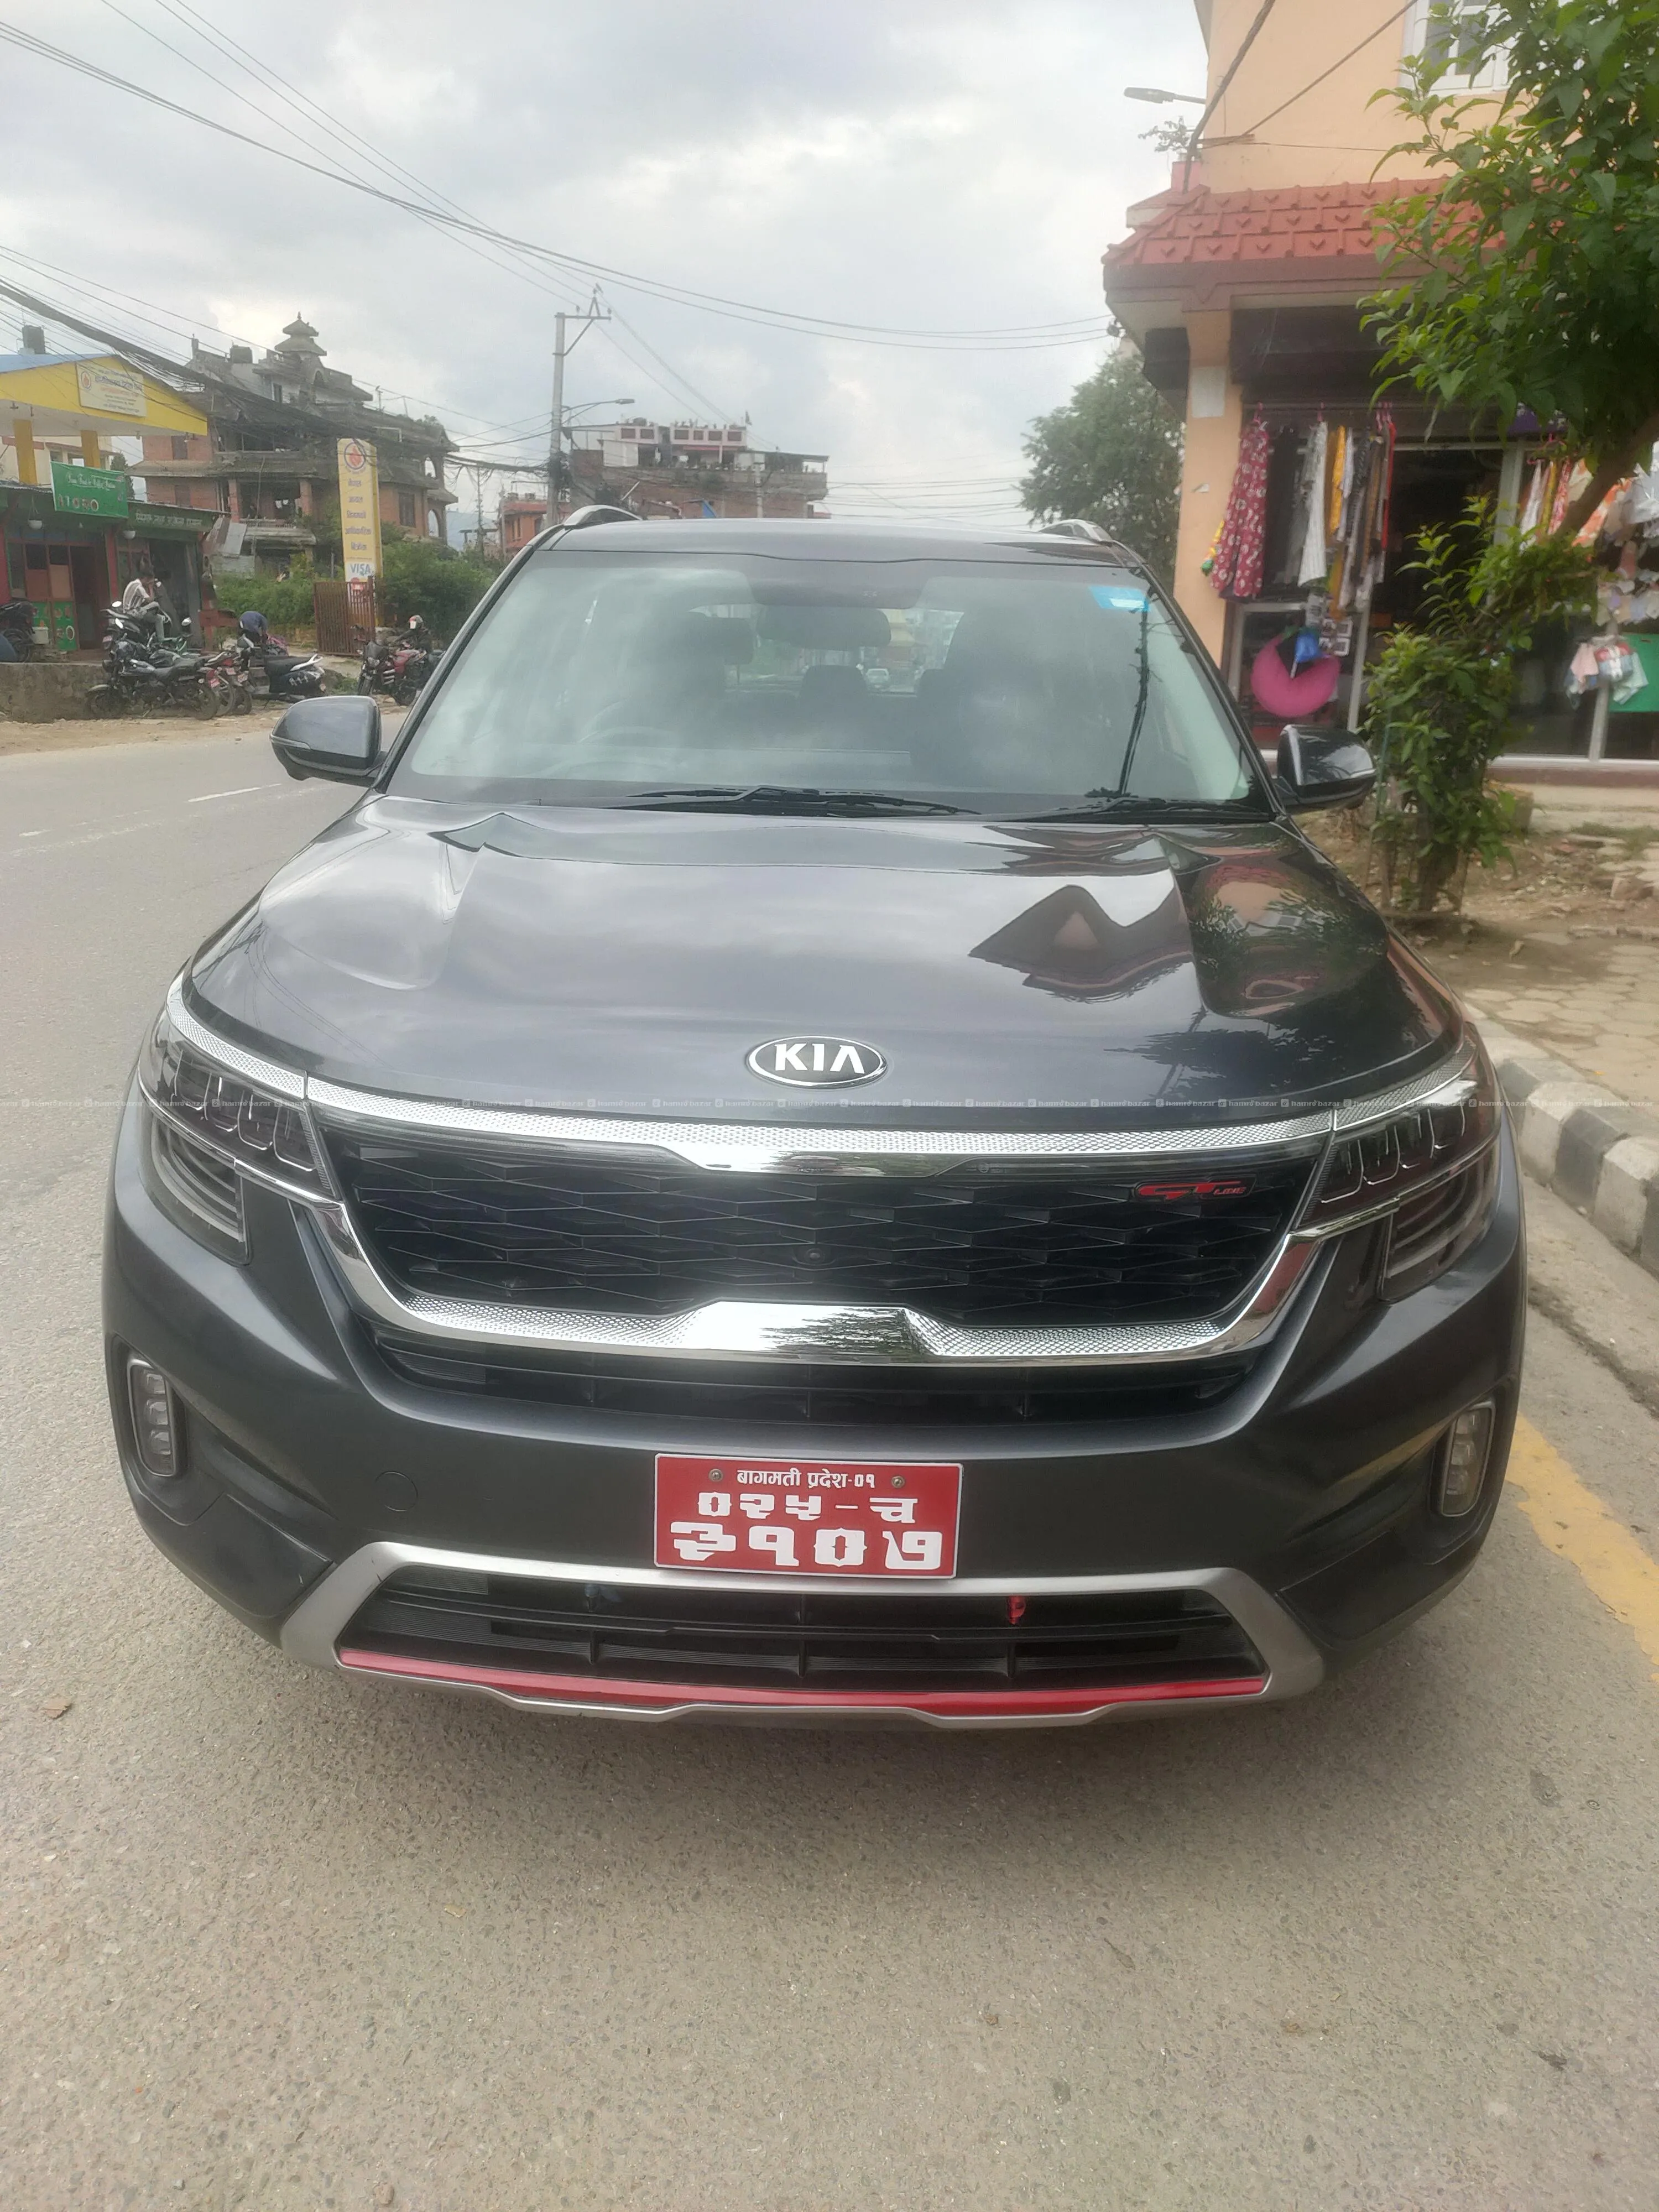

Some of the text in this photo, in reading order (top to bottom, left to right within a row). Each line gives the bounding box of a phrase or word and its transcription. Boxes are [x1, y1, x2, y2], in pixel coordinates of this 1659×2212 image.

[350, 564, 371, 573] VISA
[774, 1043, 865, 1074] KIA
[737, 1468, 801, 1486] बागमती
[670, 1521, 942, 1570] ३१०७
